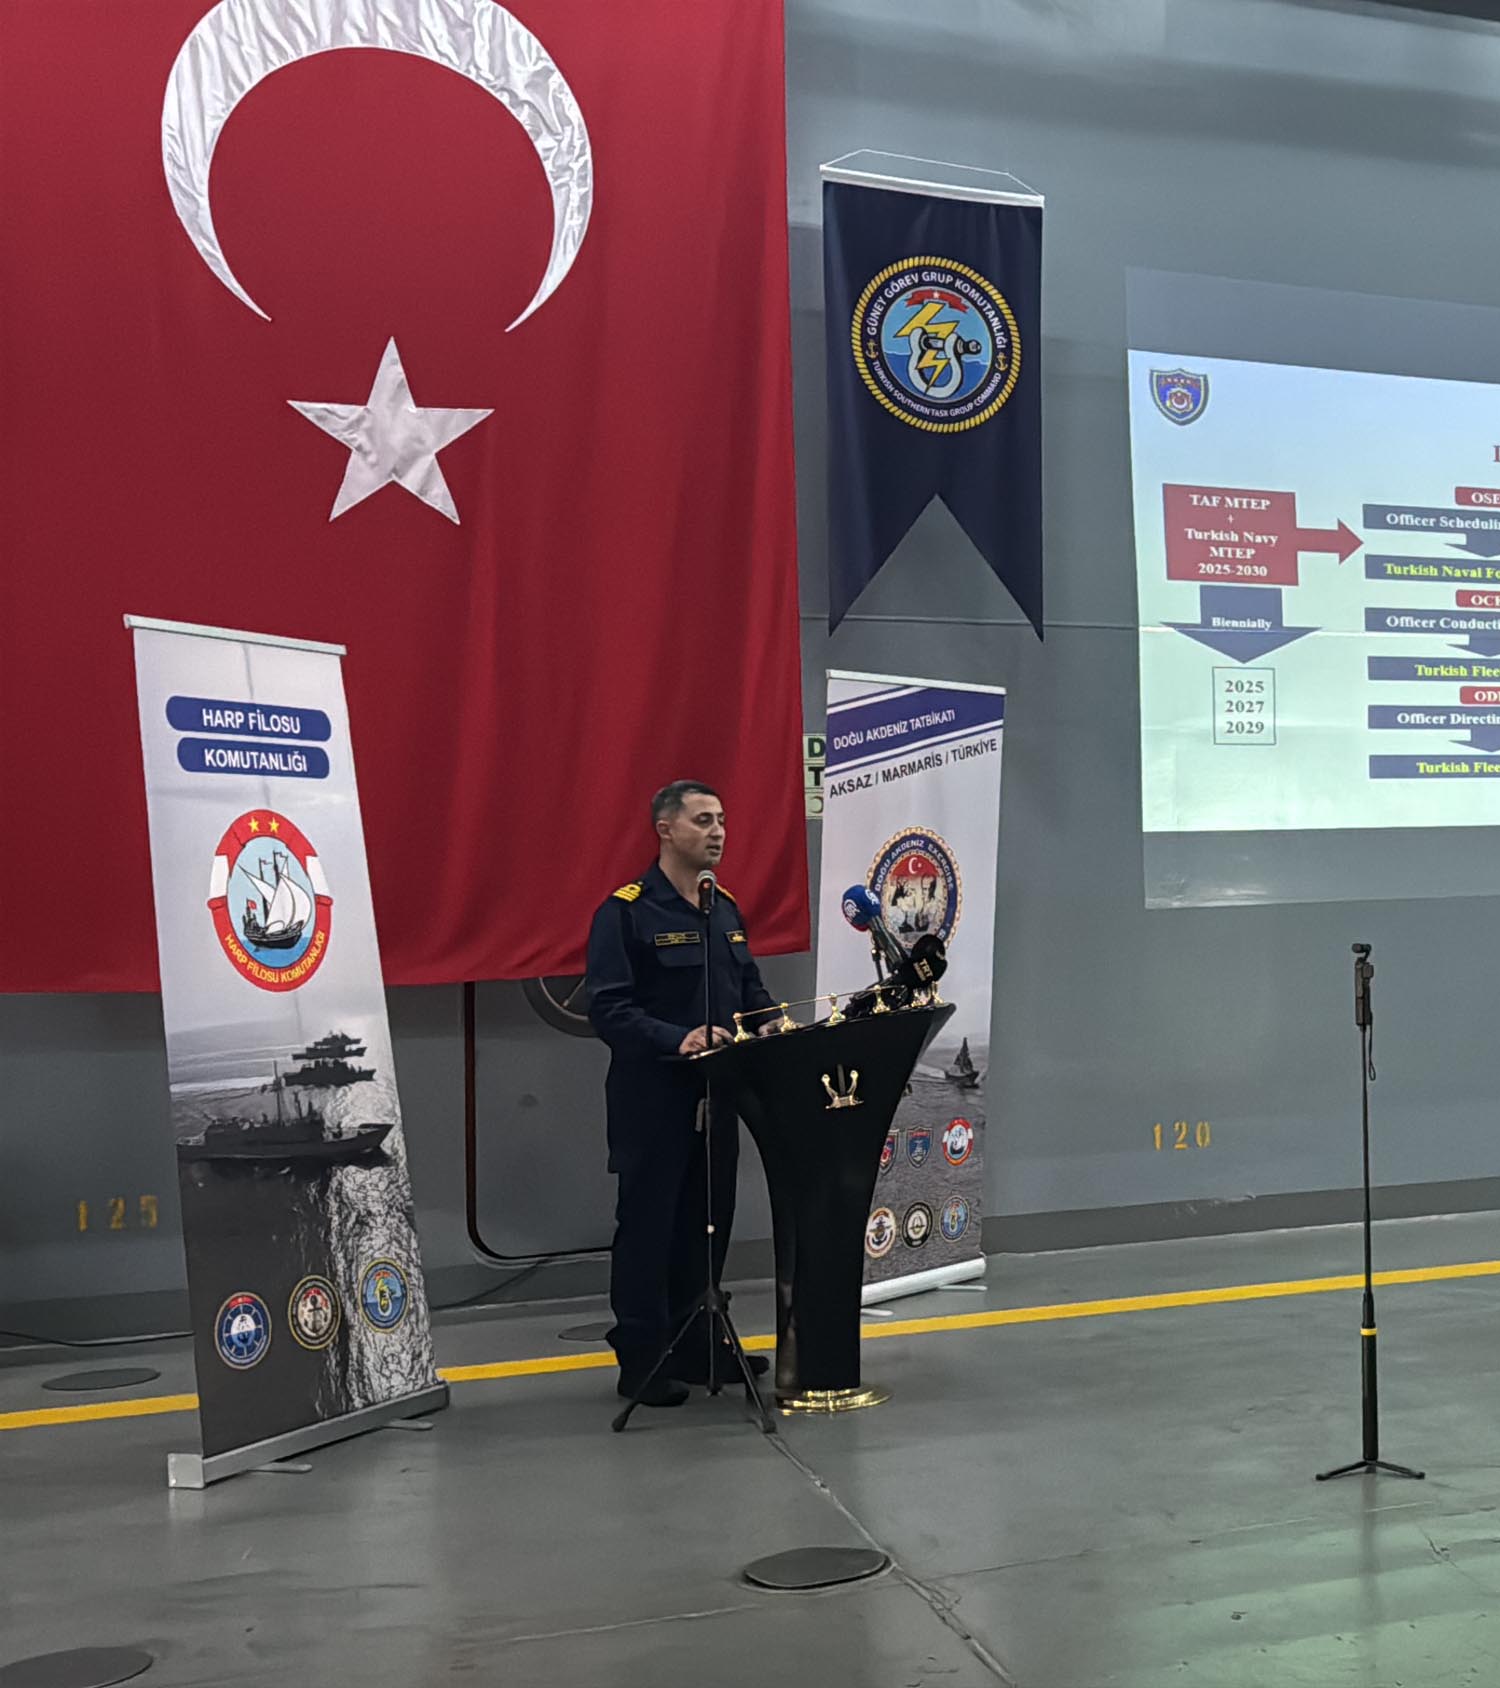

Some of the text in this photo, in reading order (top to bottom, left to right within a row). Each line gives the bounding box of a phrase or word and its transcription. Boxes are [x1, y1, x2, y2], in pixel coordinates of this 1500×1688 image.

[867, 271, 1006, 349] GÜNEY GÖREV GRUP KOMUTANLIĞI
[949, 402, 974, 417] GROUP
[974, 372, 1001, 406] COMMAND
[1189, 494, 1271, 511] TAF MTEP
[1386, 512, 1436, 528] Officer
[1184, 528, 1279, 547] Turkish Navy
[1209, 546, 1256, 559] MTEP
[1198, 563, 1268, 577] 2025-2030
[1384, 563, 1438, 577] Turkish
[1442, 564, 1482, 579] Naval
[1211, 616, 1272, 632] Biennially
[1386, 615, 1436, 630] Officer
[1415, 664, 1468, 678] Turkish
[1224, 680, 1265, 694] 2025
[1224, 700, 1265, 714] 2027
[202, 708, 301, 734] HARP FİLOSU
[1397, 712, 1447, 726] Officer
[833, 708, 956, 750] DOĞU AKDENİZ TATBİKATI
[1224, 720, 1265, 735] 2029
[204, 747, 307, 773] KOMUTANLIĞI
[829, 774, 873, 799] AKSAZ
[882, 749, 943, 783] MARMARİS
[952, 737, 998, 762] TÜRKİYE
[1416, 760, 1469, 774] Turkish
[224, 930, 326, 984] HARP FİLOSU KOMUTANLIĞI
[919, 958, 933, 977] TRT
[1153, 1121, 1211, 1151] 120
